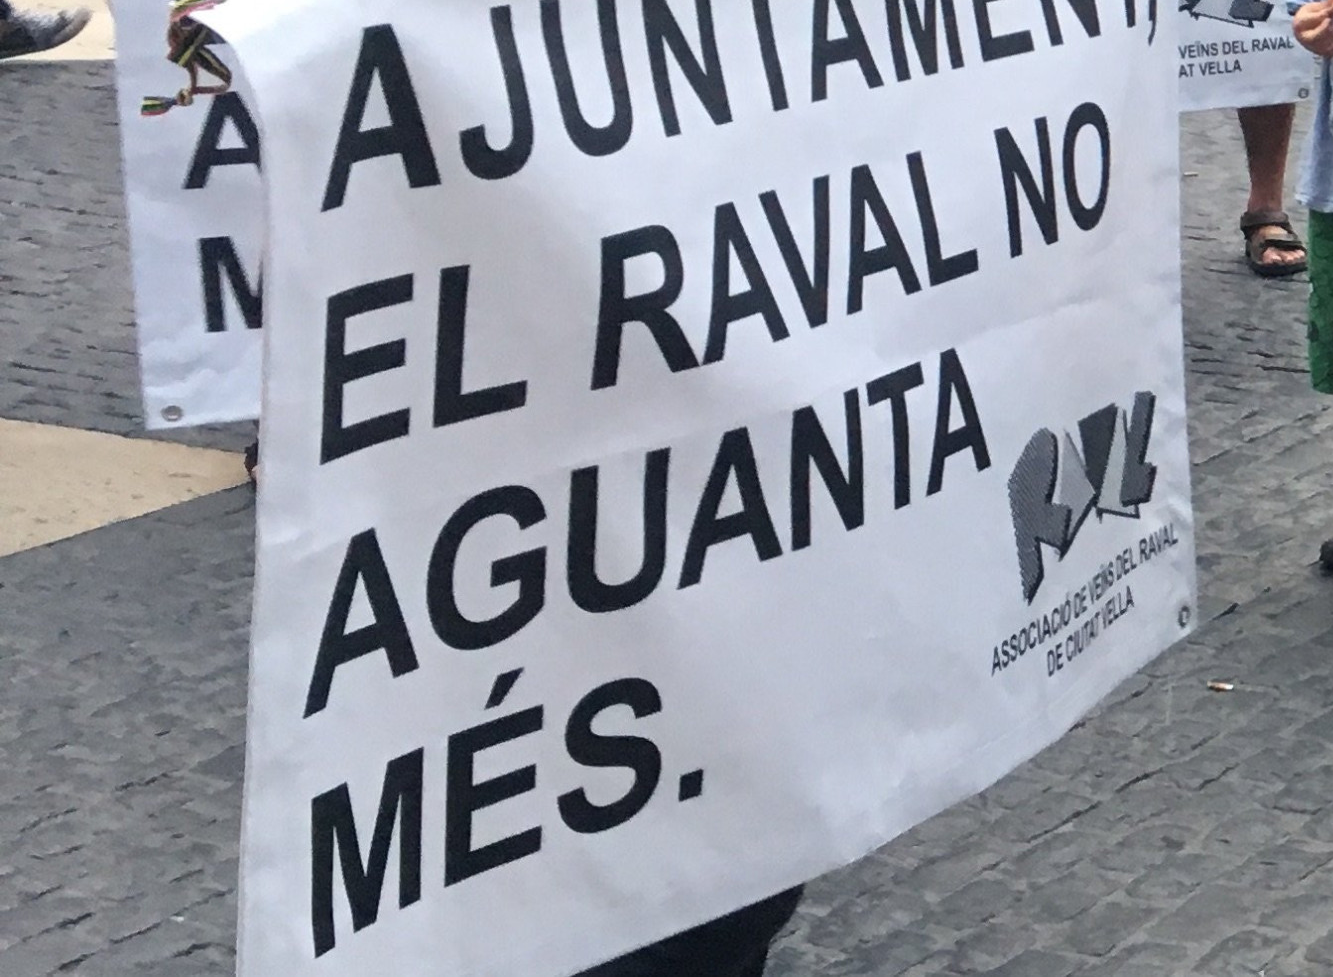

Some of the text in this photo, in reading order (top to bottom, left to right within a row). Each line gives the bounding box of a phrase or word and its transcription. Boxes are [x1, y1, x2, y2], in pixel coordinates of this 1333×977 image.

[1199, 59, 1242, 77] VELLA
[1222, 41, 1248, 55] DEL
[1251, 36, 1294, 52] RAVAL
[321, 265, 527, 464] EL
[591, 153, 979, 390] RAVAL
[994, 102, 1111, 258] NO
[304, 349, 991, 718] AGUANTA
[991, 590, 1072, 677] ASSOCIACIÓ
[1073, 585, 1088, 619] DE
[1114, 548, 1138, 581] DEL
[1139, 522, 1178, 562] RAVAL
[1046, 585, 1135, 677] DE CIUTAT VELLA
[312, 668, 704, 958] MÉS.
